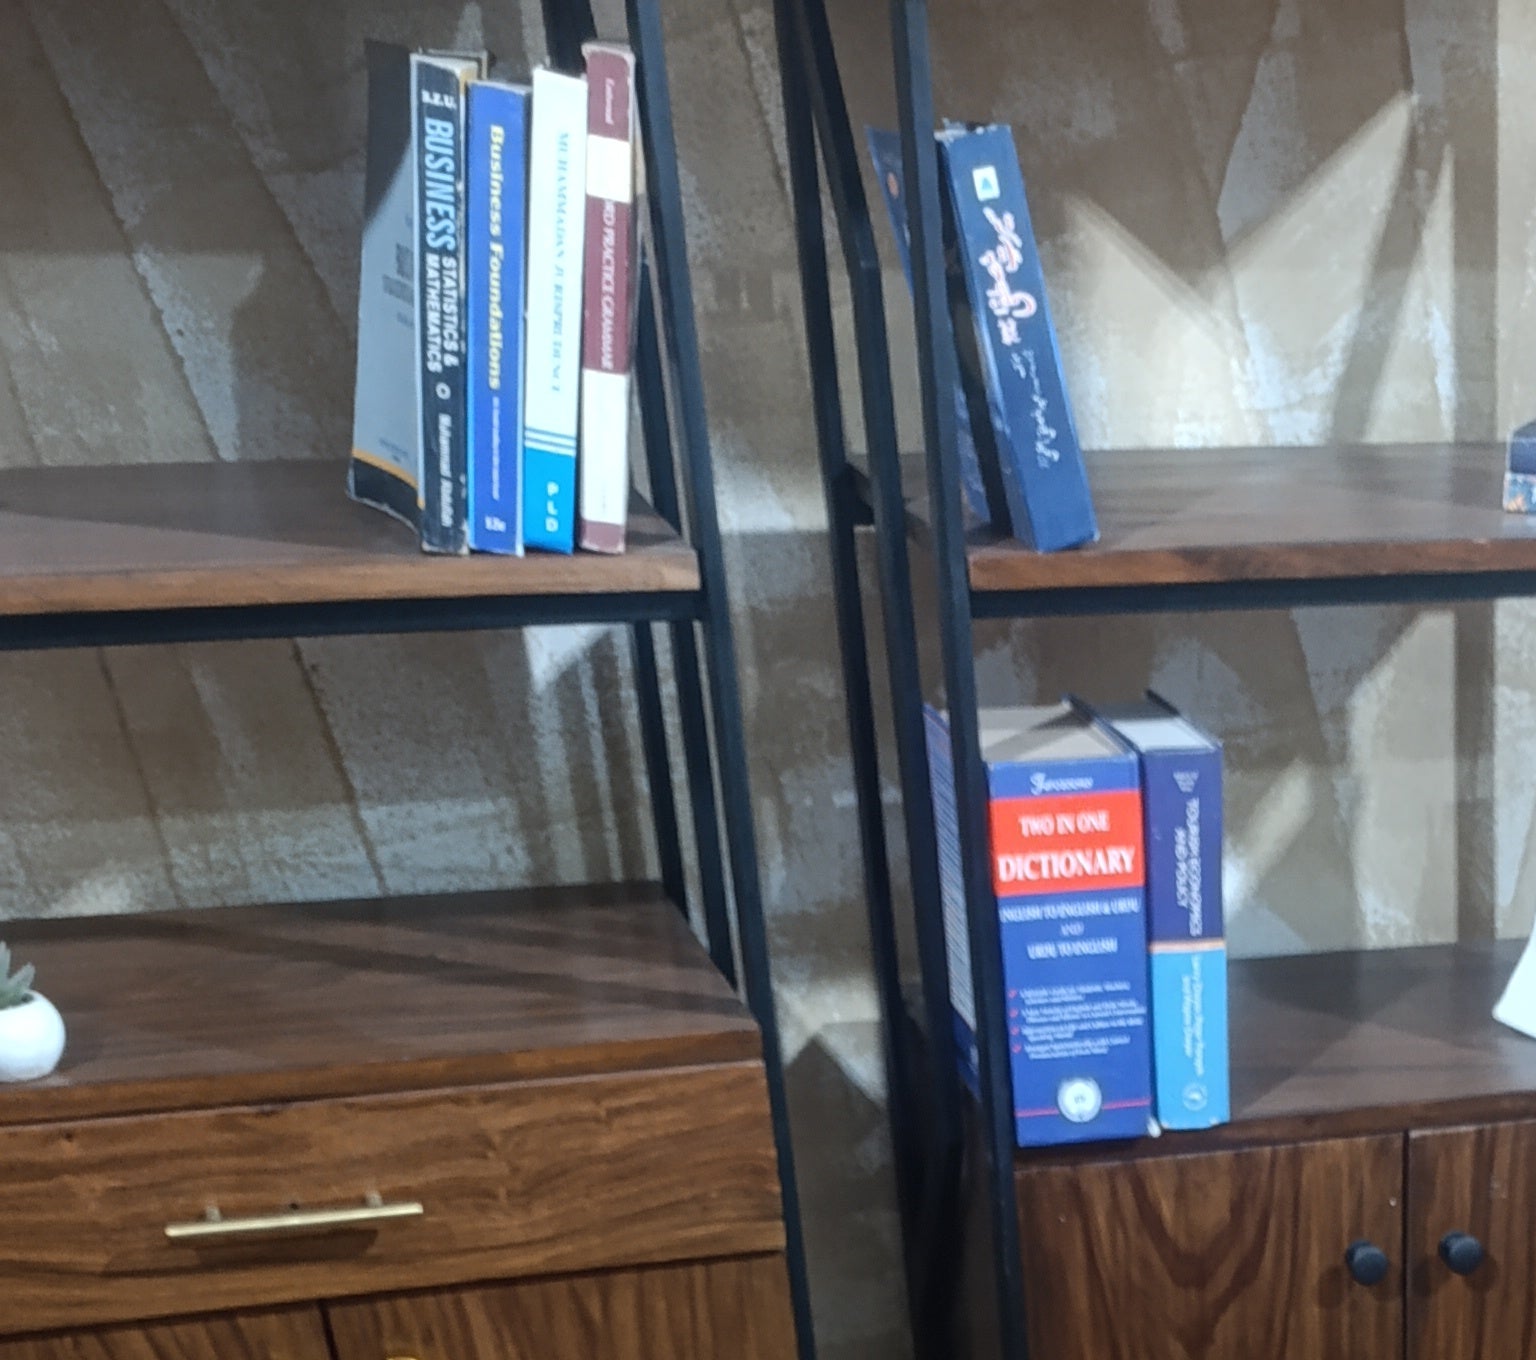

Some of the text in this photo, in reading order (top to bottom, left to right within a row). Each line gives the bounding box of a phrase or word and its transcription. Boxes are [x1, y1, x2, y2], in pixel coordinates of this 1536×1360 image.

[424, 116, 457, 251] BUSINESS
[489, 124, 504, 238] Business
[426, 253, 443, 374] MATHEMATICS
[441, 255, 460, 367] STATISTICS &
[488, 241, 504, 391] Foundations
[602, 227, 616, 293] PRACTICE
[601, 295, 616, 370] GRAMMAR
[998, 846, 1136, 882] DICTIONARY
[1020, 810, 1110, 838] TWO IN ONE
